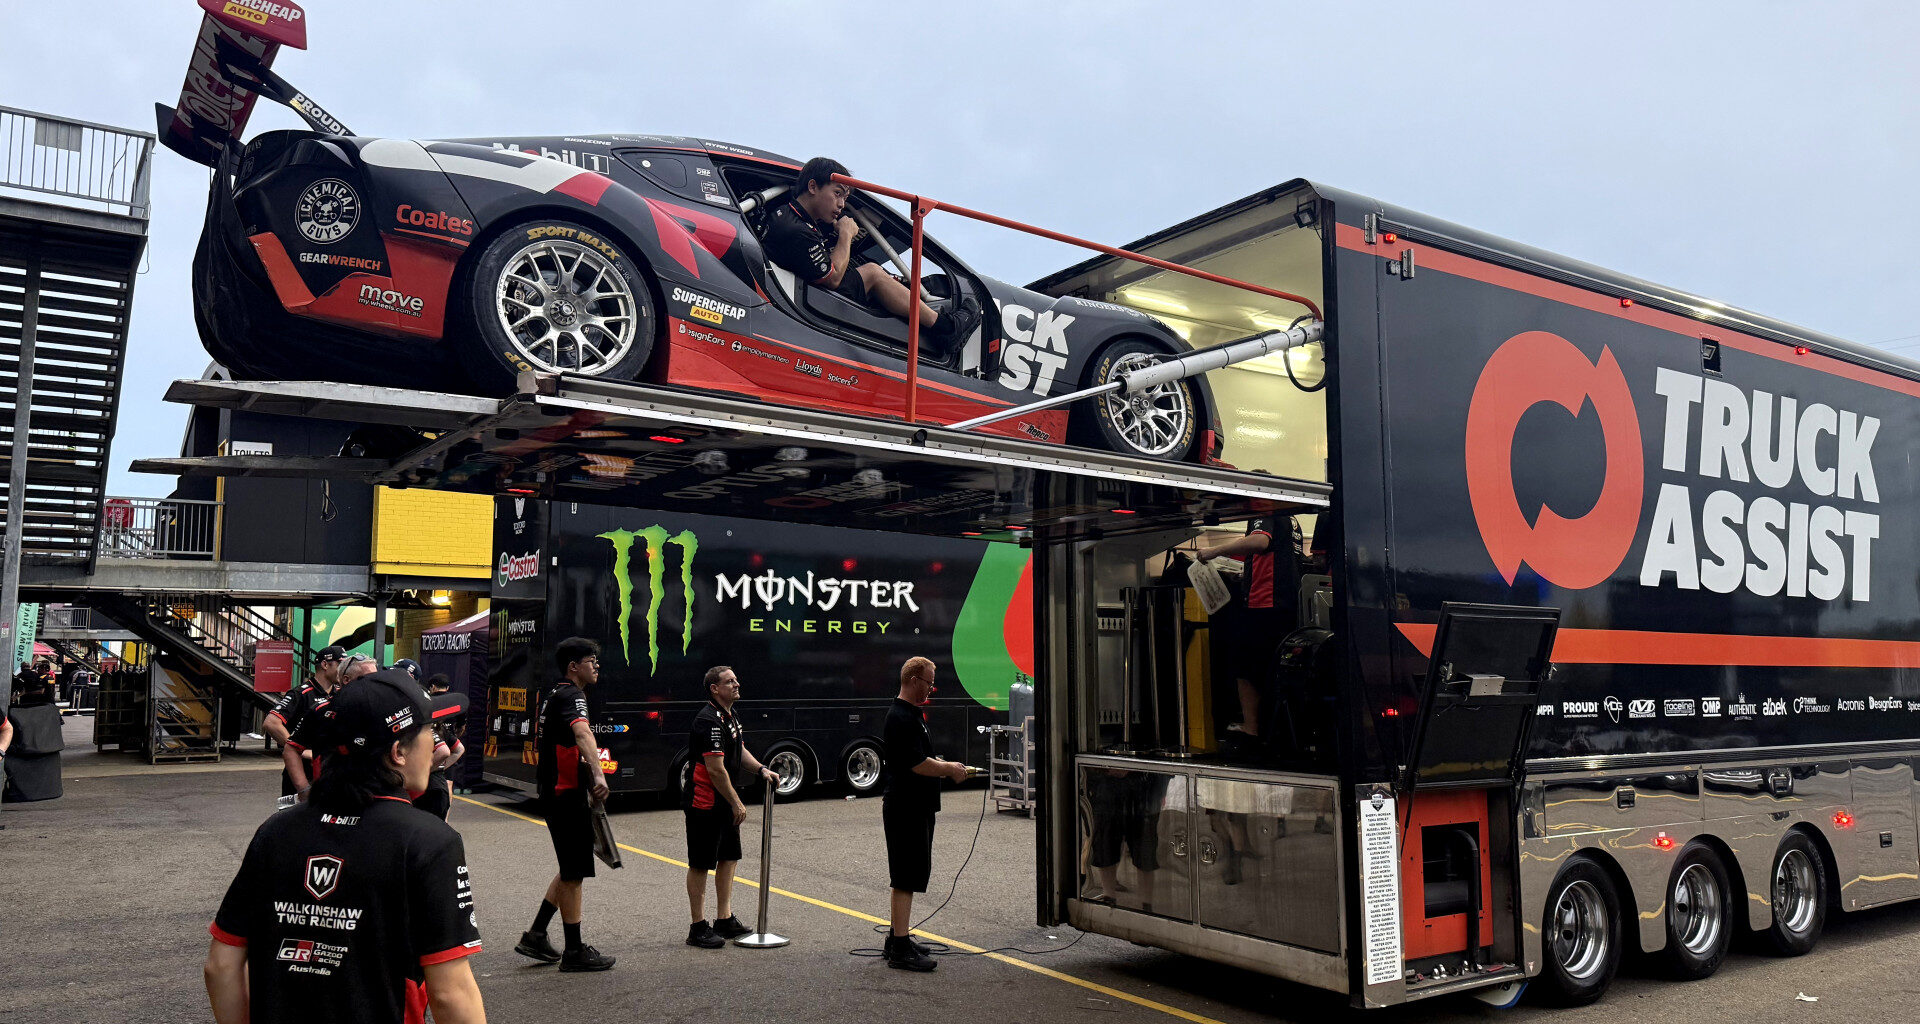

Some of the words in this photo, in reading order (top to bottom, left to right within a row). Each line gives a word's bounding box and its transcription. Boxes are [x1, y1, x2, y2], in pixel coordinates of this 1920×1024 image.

[228, 6, 263, 21] AUTO
[301, 183, 354, 213] CHEMICAL
[396, 204, 473, 236] Coates
[307, 224, 342, 239] GUYS
[526, 226, 577, 240] SPORT
[577, 231, 621, 260] MAXX
[300, 252, 380, 271] GEARWRENCH
[359, 297, 370, 306] my
[360, 284, 424, 311] move
[672, 287, 746, 320] SUPERCHEAP
[693, 309, 719, 321] AUTO
[796, 358, 823, 374] Lloyds
[1027, 423, 1050, 441] Repco
[1655, 367, 1881, 504] TRUCK
[1640, 482, 1880, 602] ASSIST
[509, 549, 540, 582] Castrol
[750, 618, 890, 634] ENERGY
[17, 631, 27, 662] SNOWY
[422, 634, 447, 650] TICKFORD
[448, 633, 471, 650] RACING
[1563, 702, 1598, 713] PROUDI
[1702, 701, 1721, 713] OMP
[1728, 703, 1757, 715] AUTHENTIC
[1837, 698, 1865, 711] Acronis
[1868, 696, 1903, 711] DesignEars
[321, 814, 348, 825] Mobil
[313, 866, 335, 886] W
[274, 901, 363, 919] WALKINSHAW
[277, 913, 306, 925] TWG
[310, 916, 356, 931] RACING
[279, 947, 312, 961] GR
[313, 949, 343, 959] GAZOO
[315, 942, 349, 952] TOYOTA
[312, 956, 341, 967] Racing
[288, 964, 331, 976] Australia
